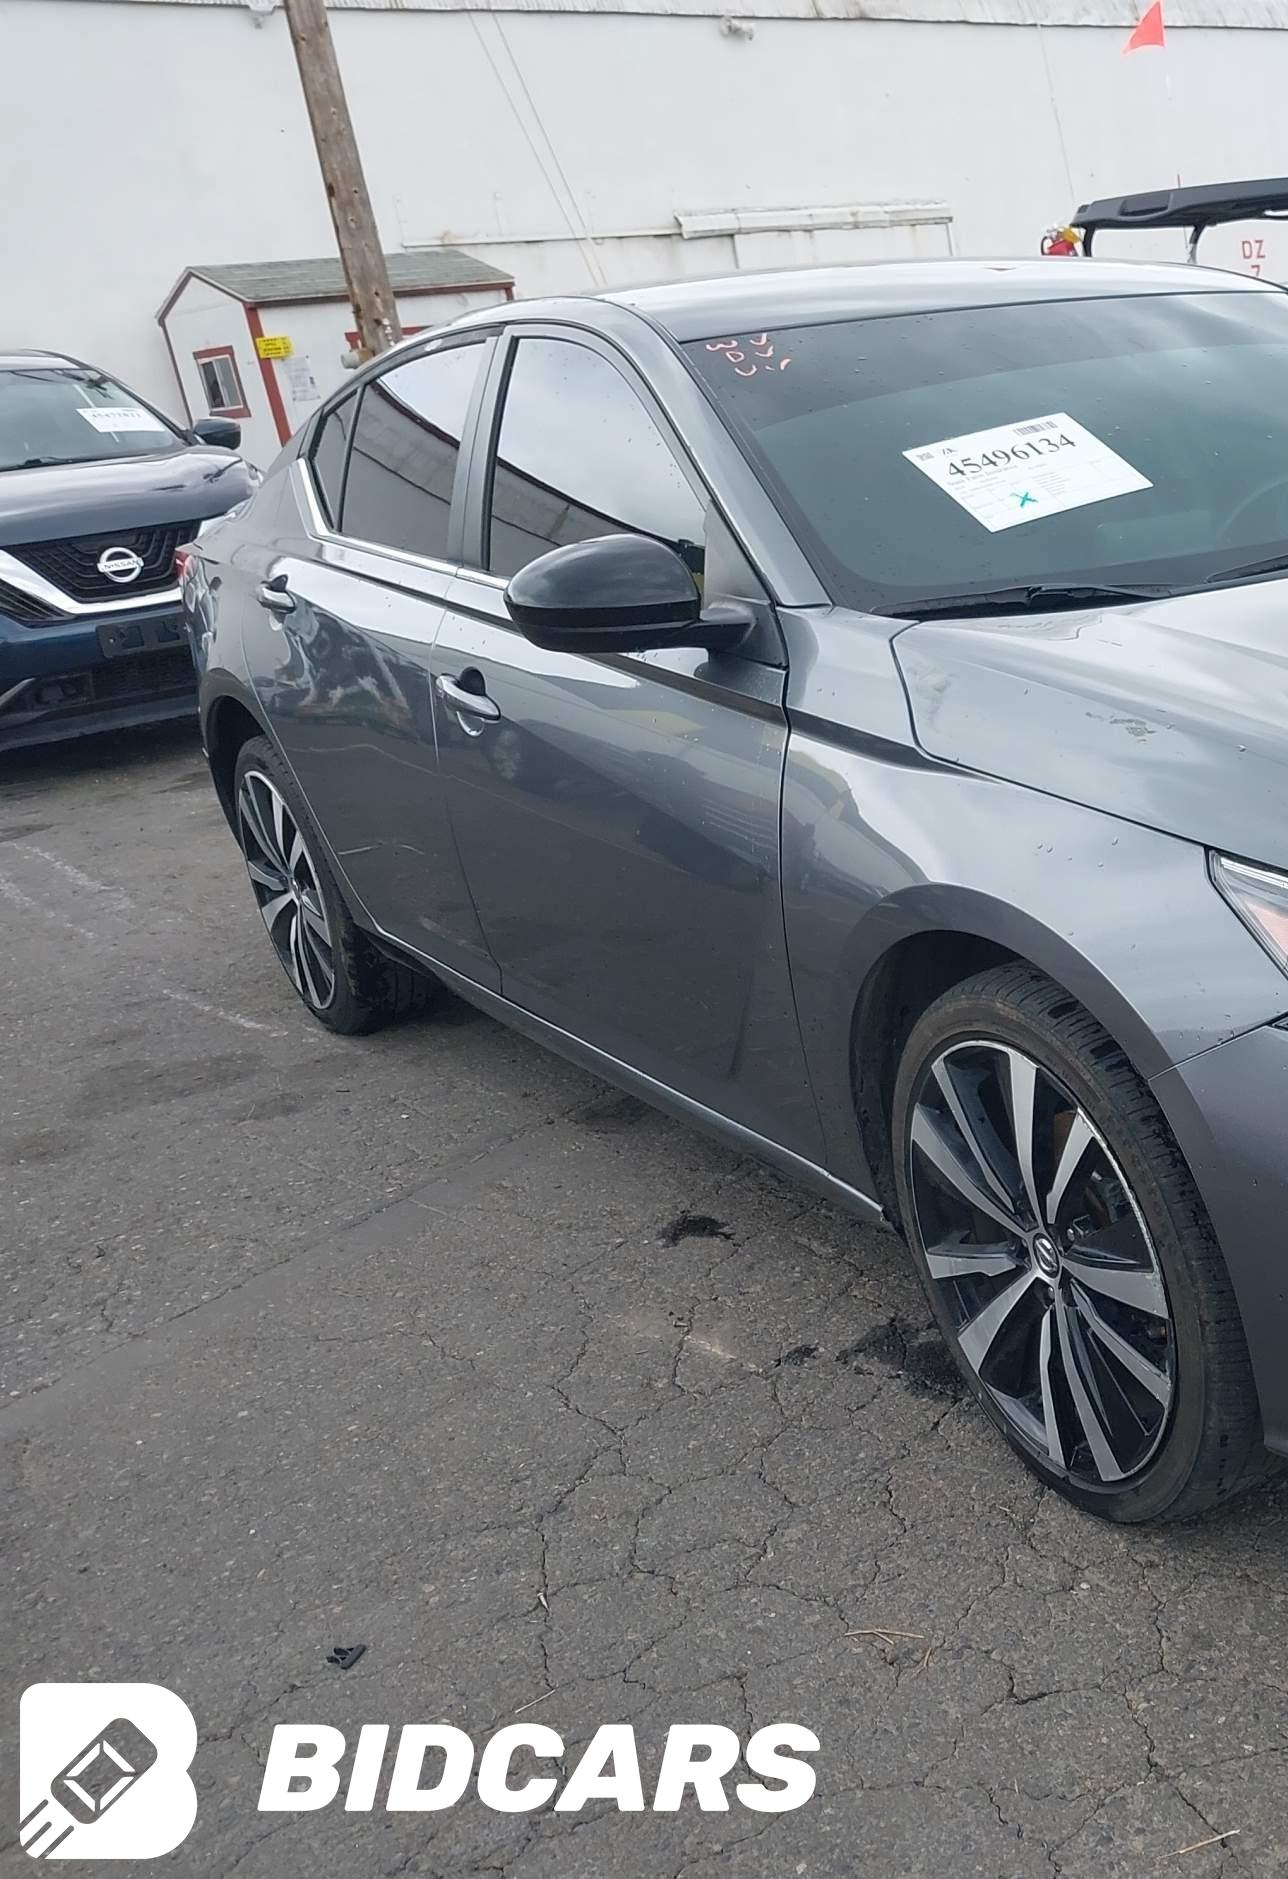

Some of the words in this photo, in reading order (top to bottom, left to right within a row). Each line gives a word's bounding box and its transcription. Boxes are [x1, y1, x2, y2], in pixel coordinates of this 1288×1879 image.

[1241, 239, 1265, 260] DZ
[1250, 264, 1261, 278] 7
[948, 433, 1077, 477] 45496134
